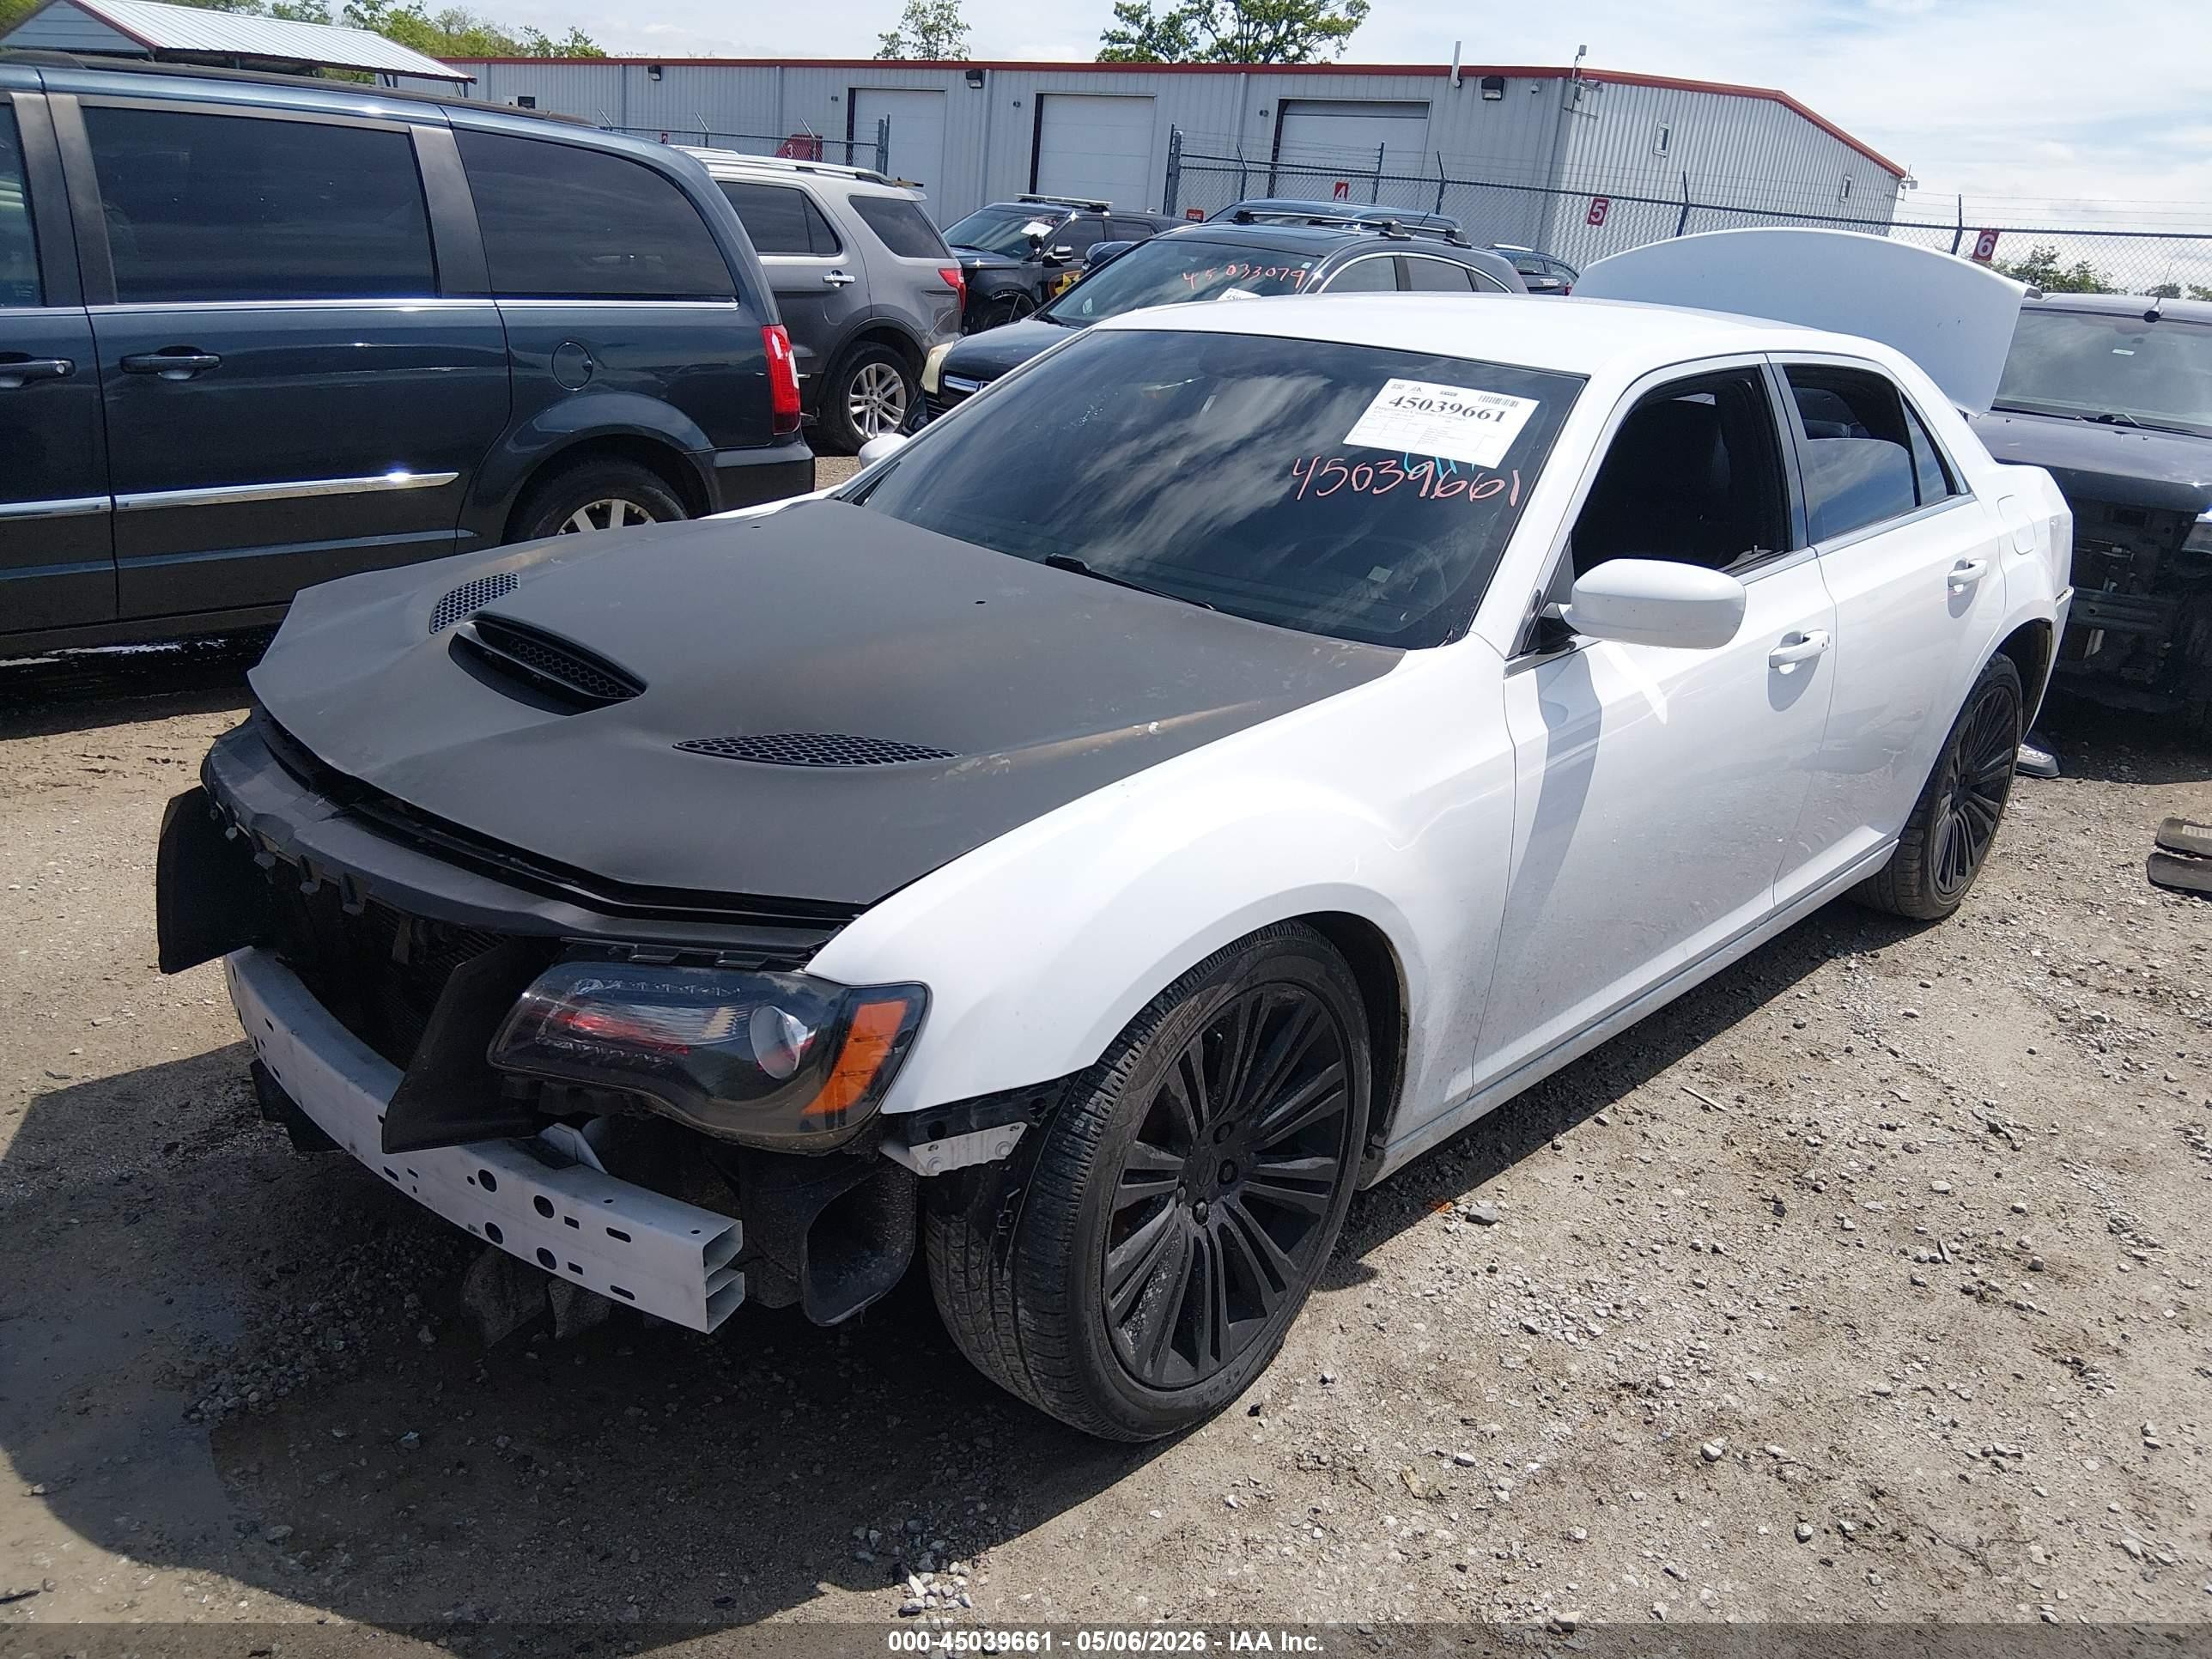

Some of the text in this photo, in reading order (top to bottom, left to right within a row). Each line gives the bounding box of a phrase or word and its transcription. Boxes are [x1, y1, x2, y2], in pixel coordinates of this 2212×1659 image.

[787, 143, 793, 158] 3
[1590, 202, 1606, 222] 5
[1978, 234, 1995, 256] 6
[1389, 394, 1507, 423] 45039661
[1292, 455, 1521, 507] 45039661
